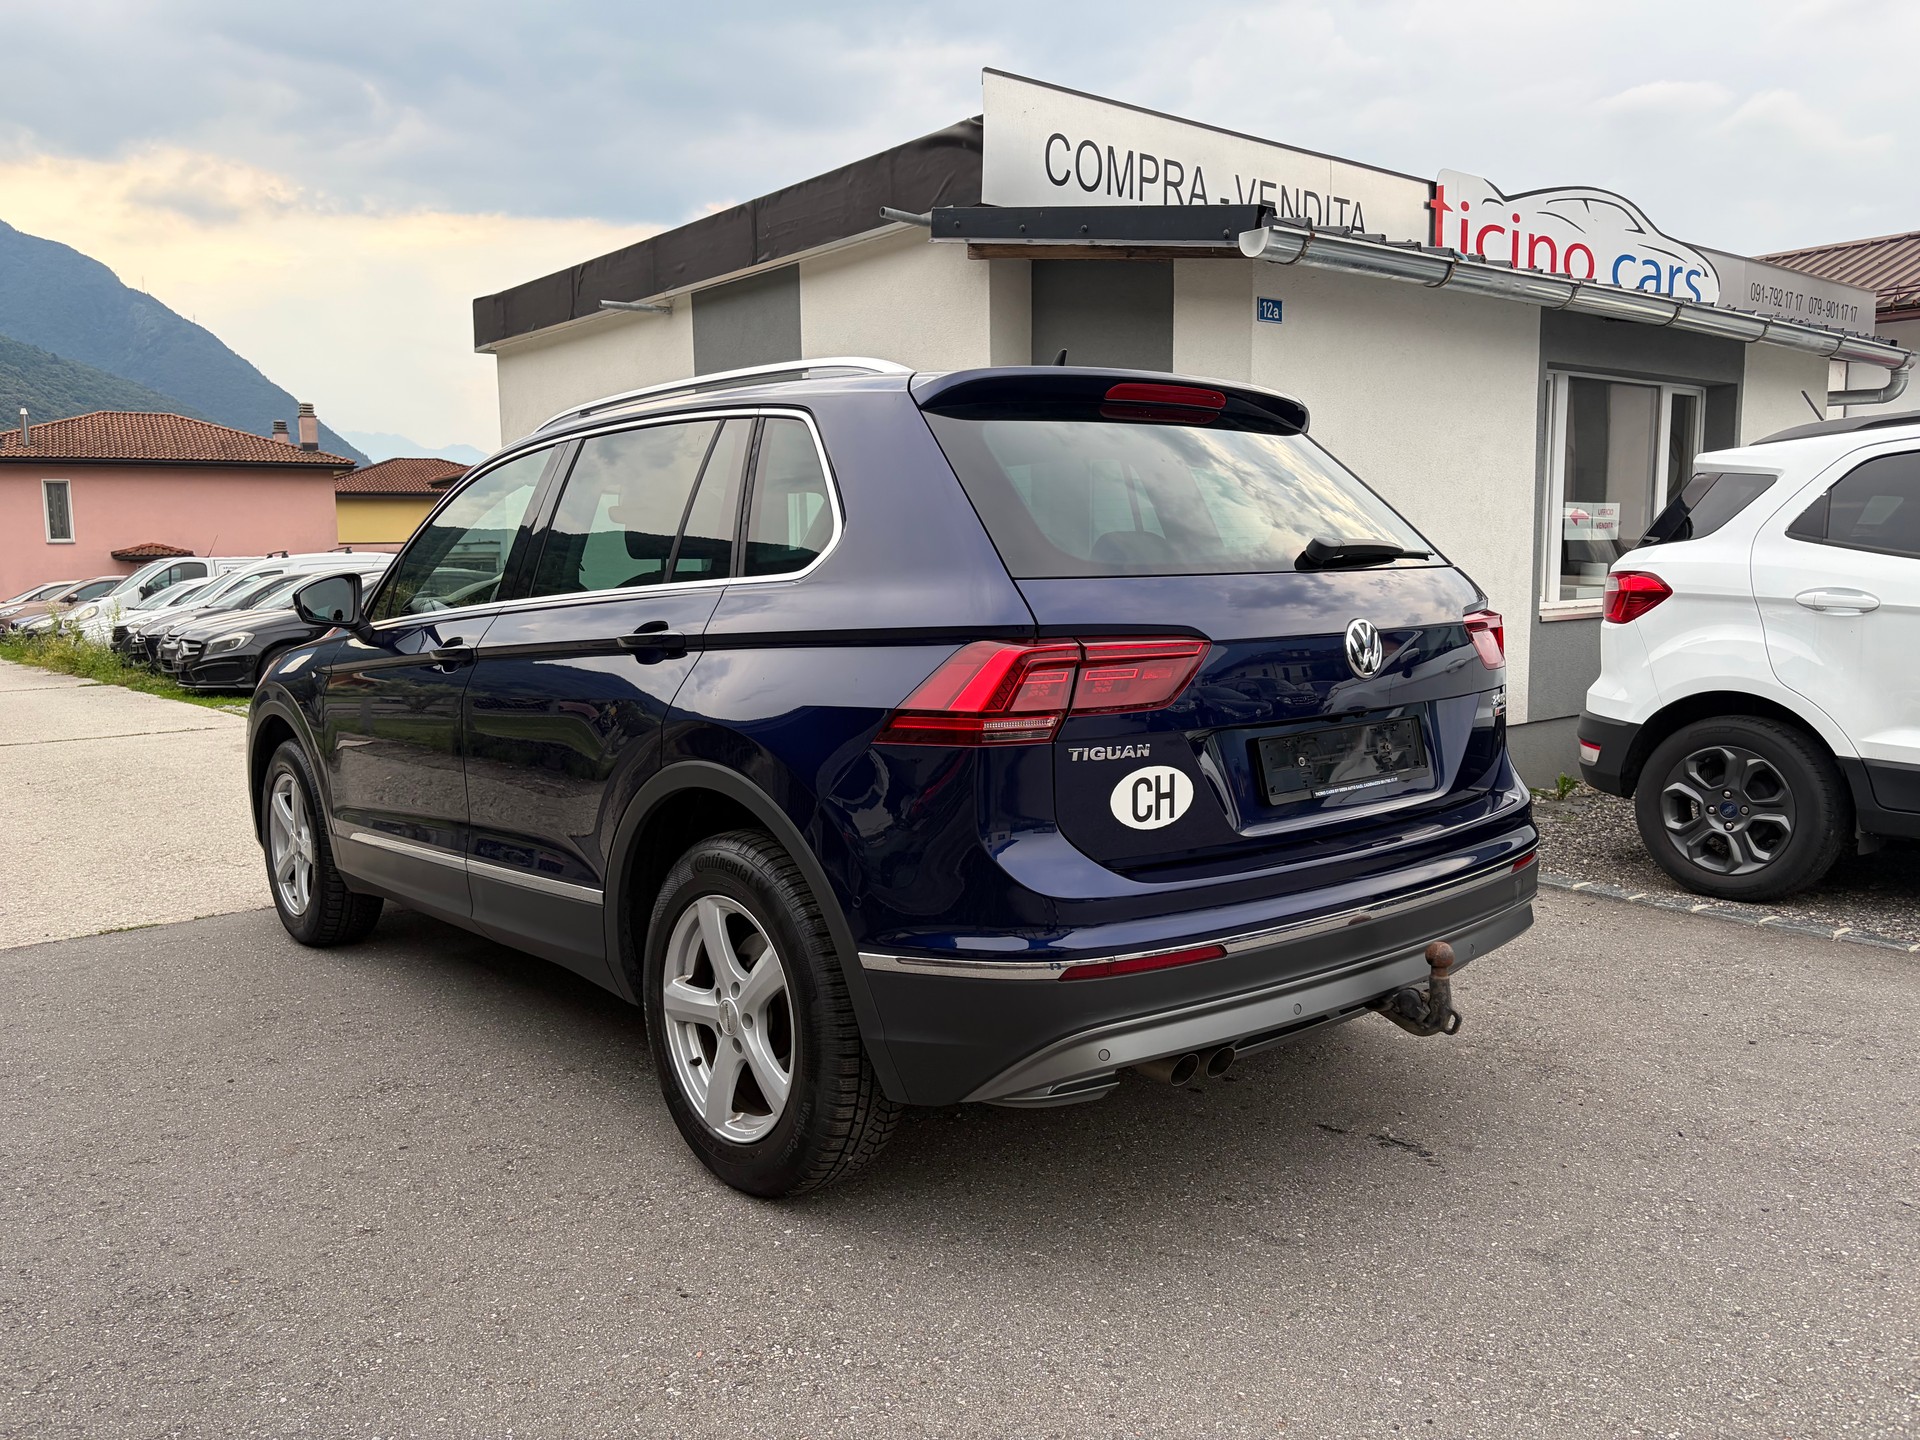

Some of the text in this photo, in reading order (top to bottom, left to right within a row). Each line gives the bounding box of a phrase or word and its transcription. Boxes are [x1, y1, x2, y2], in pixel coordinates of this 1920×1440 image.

[1045, 132, 1208, 205] COMPRA
[1235, 174, 1365, 234] VENDITA
[1430, 184, 1702, 302] ticino cars
[1262, 301, 1279, 319] 12a
[1750, 282, 1783, 308] 091-792
[1785, 291, 1794, 310] 17
[1795, 294, 1804, 312] 17
[1808, 296, 1839, 319] 079-901
[1850, 306, 1858, 323] 17
[1068, 743, 1150, 762] TIGUAN
[1132, 773, 1175, 823] CH
[695, 852, 755, 885] Continental
